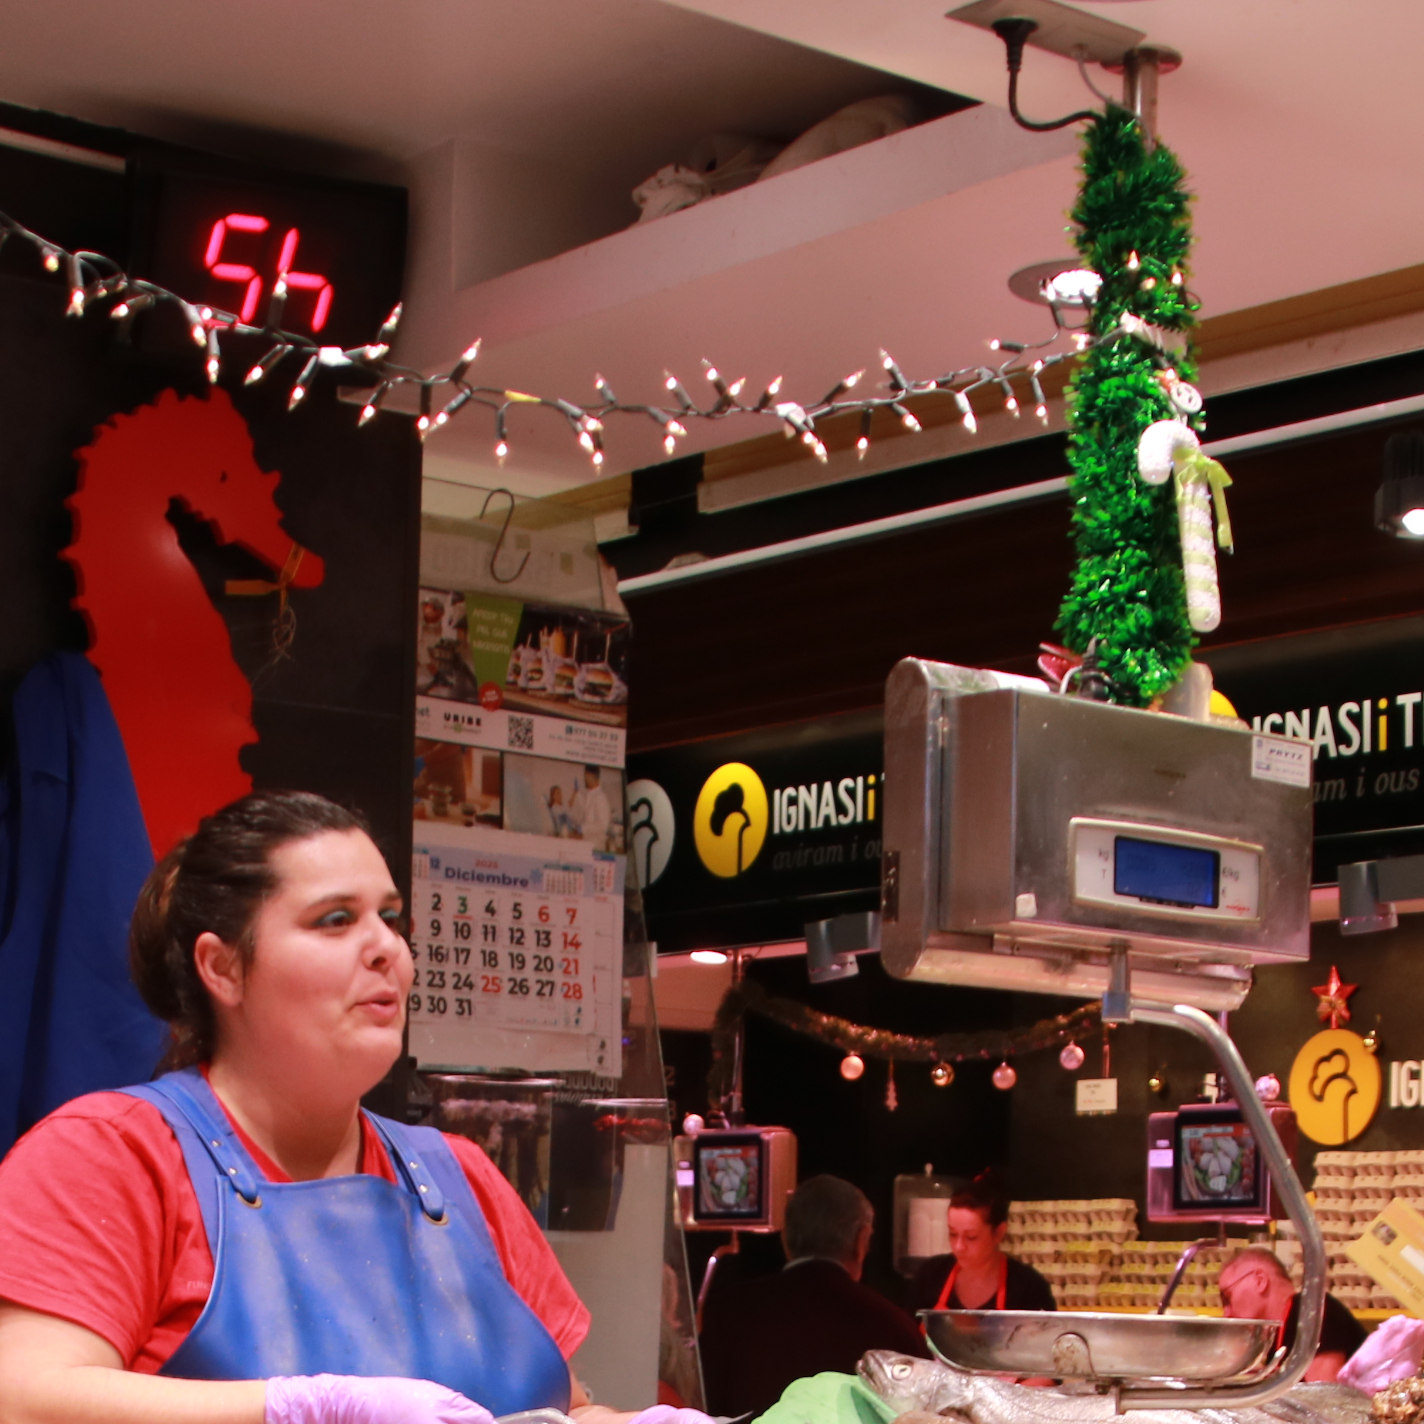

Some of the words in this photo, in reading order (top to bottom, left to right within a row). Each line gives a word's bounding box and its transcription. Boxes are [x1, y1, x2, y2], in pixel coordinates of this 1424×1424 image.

[773, 775, 864, 835] IGNASI
[445, 867, 529, 888] Diciembre
[432, 894, 441, 911] 2
[458, 896, 467, 914] 3
[485, 900, 496, 917] 4
[513, 902, 522, 920] 5
[538, 905, 549, 923] 6
[566, 908, 576, 924] 7
[431, 920, 441, 936] 9
[453, 922, 471, 940] 10
[483, 924, 496, 942] 11
[509, 927, 525, 945] 12
[535, 930, 551, 948] 13
[563, 932, 581, 950] 14
[428, 944, 444, 962] 16
[454, 948, 470, 965] 17
[481, 950, 498, 968] 18
[509, 953, 526, 970] 19
[533, 955, 554, 972] 20
[562, 958, 578, 975] 21
[427, 971, 445, 989] 23
[453, 972, 474, 990] 24
[481, 976, 501, 993] 25
[508, 977, 530, 995] 26
[536, 980, 555, 997] 27
[563, 982, 582, 1000] 28
[428, 995, 447, 1014] 30
[456, 998, 472, 1015] 31
